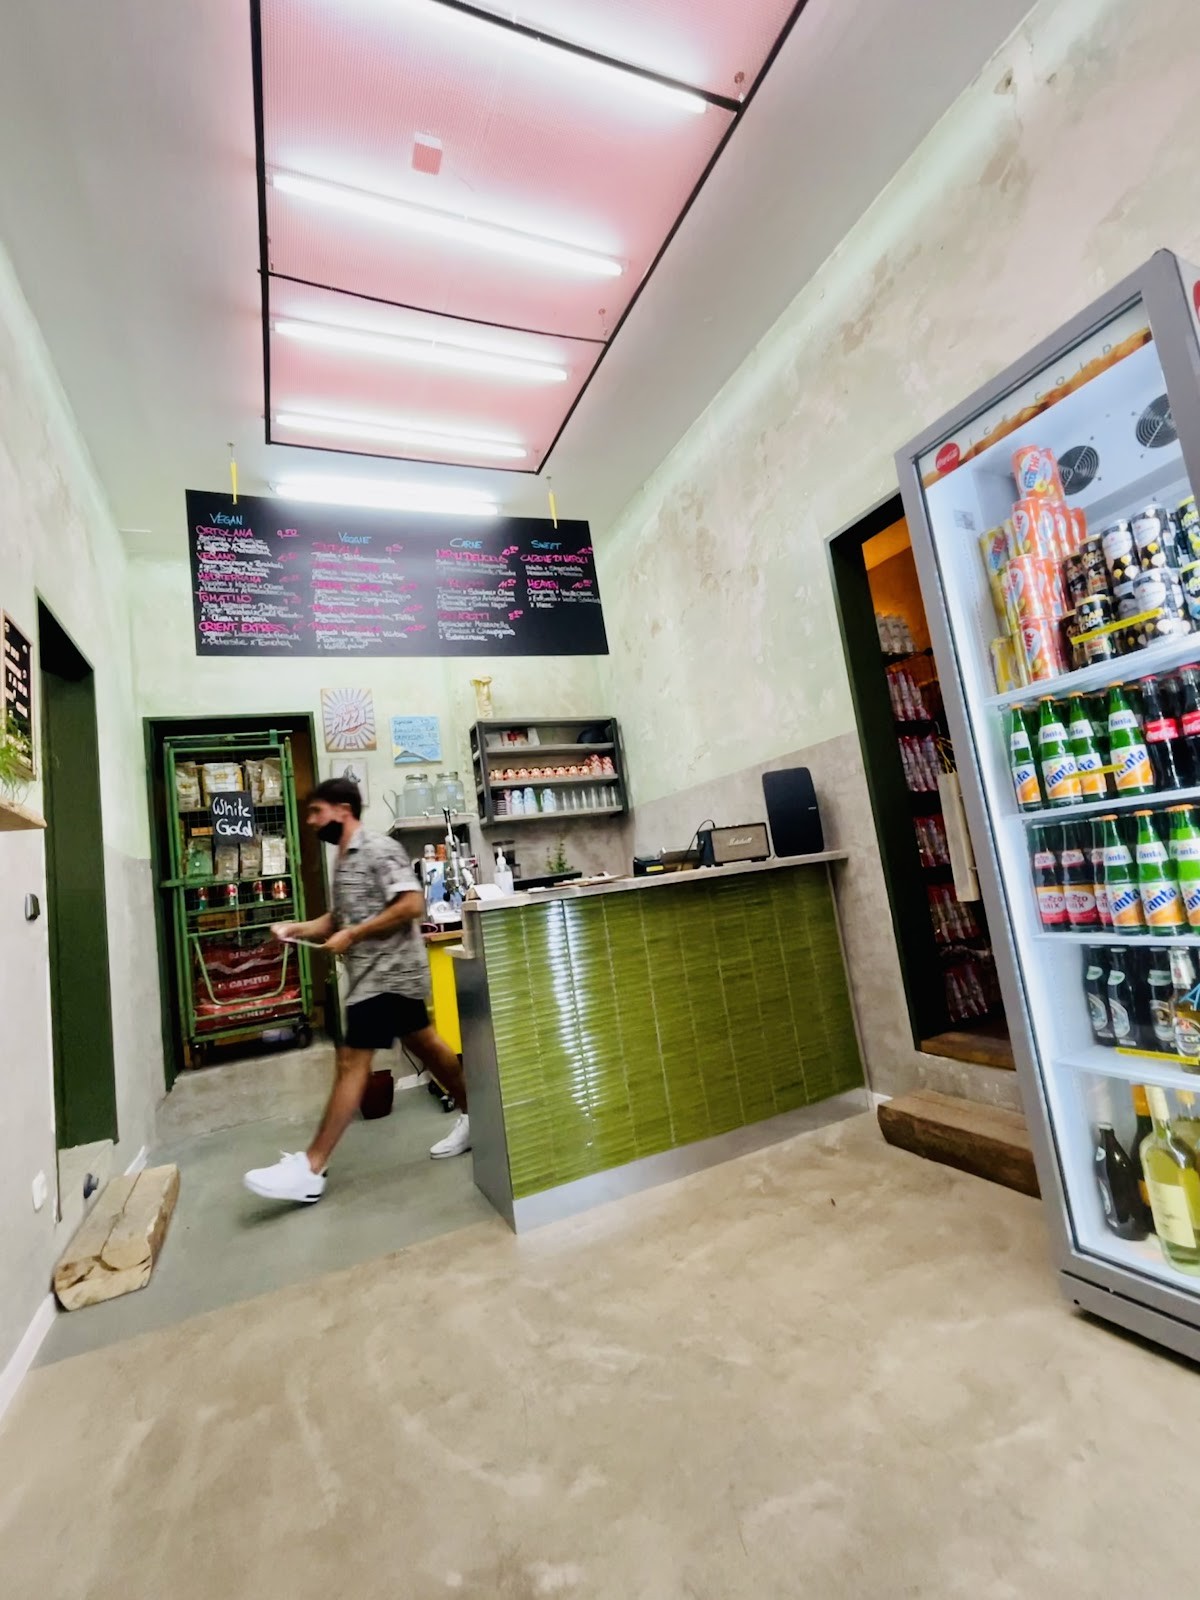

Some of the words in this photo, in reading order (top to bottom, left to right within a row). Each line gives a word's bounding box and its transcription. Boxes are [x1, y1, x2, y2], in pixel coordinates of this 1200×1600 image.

[195, 525, 253, 538] ORTOLANA
[199, 622, 238, 632] ORIENT
[212, 796, 252, 818] White
